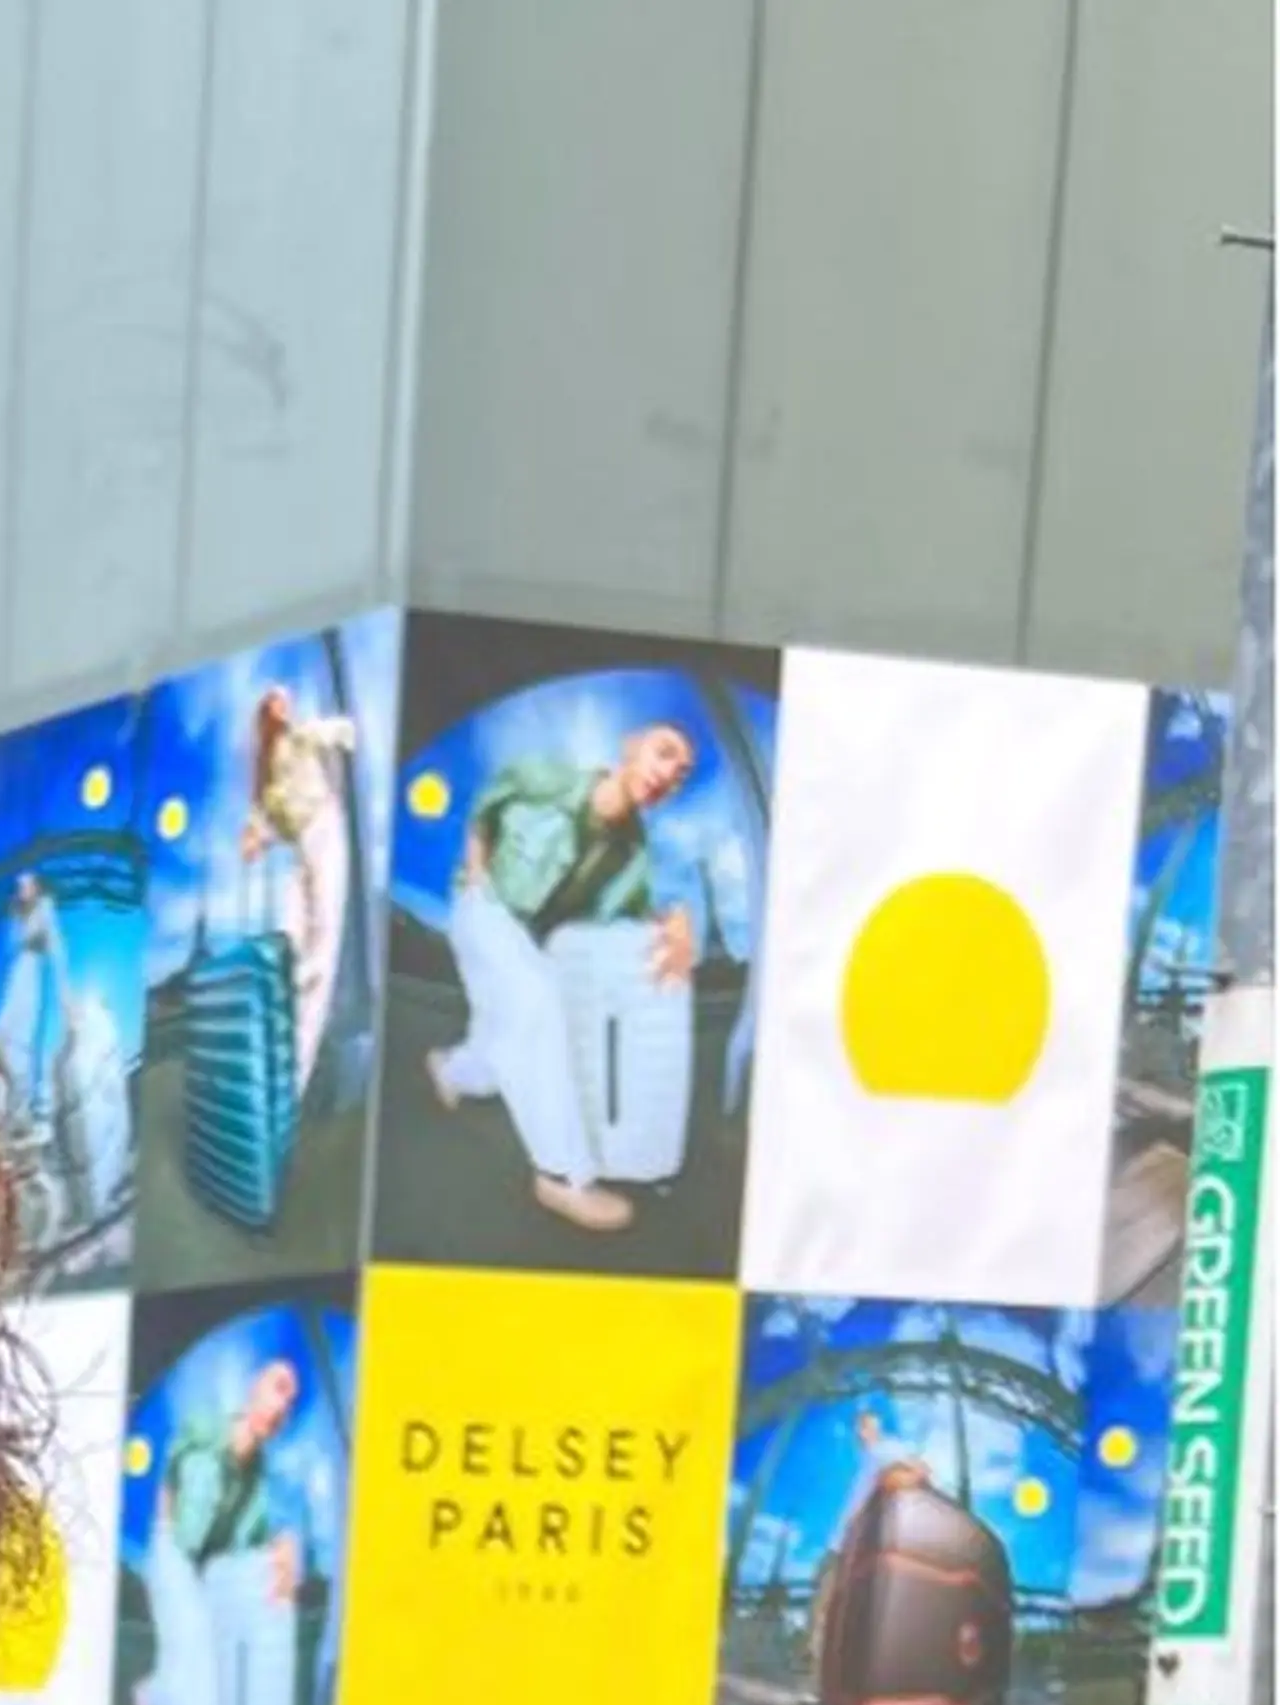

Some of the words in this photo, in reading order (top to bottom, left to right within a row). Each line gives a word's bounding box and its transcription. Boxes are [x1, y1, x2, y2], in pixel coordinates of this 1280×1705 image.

[1173, 1173, 1237, 1423] GREEN
[400, 1419, 692, 1483] DELSEY
[426, 1497, 654, 1557] PARIS
[1158, 1434, 1217, 1625] SEED
